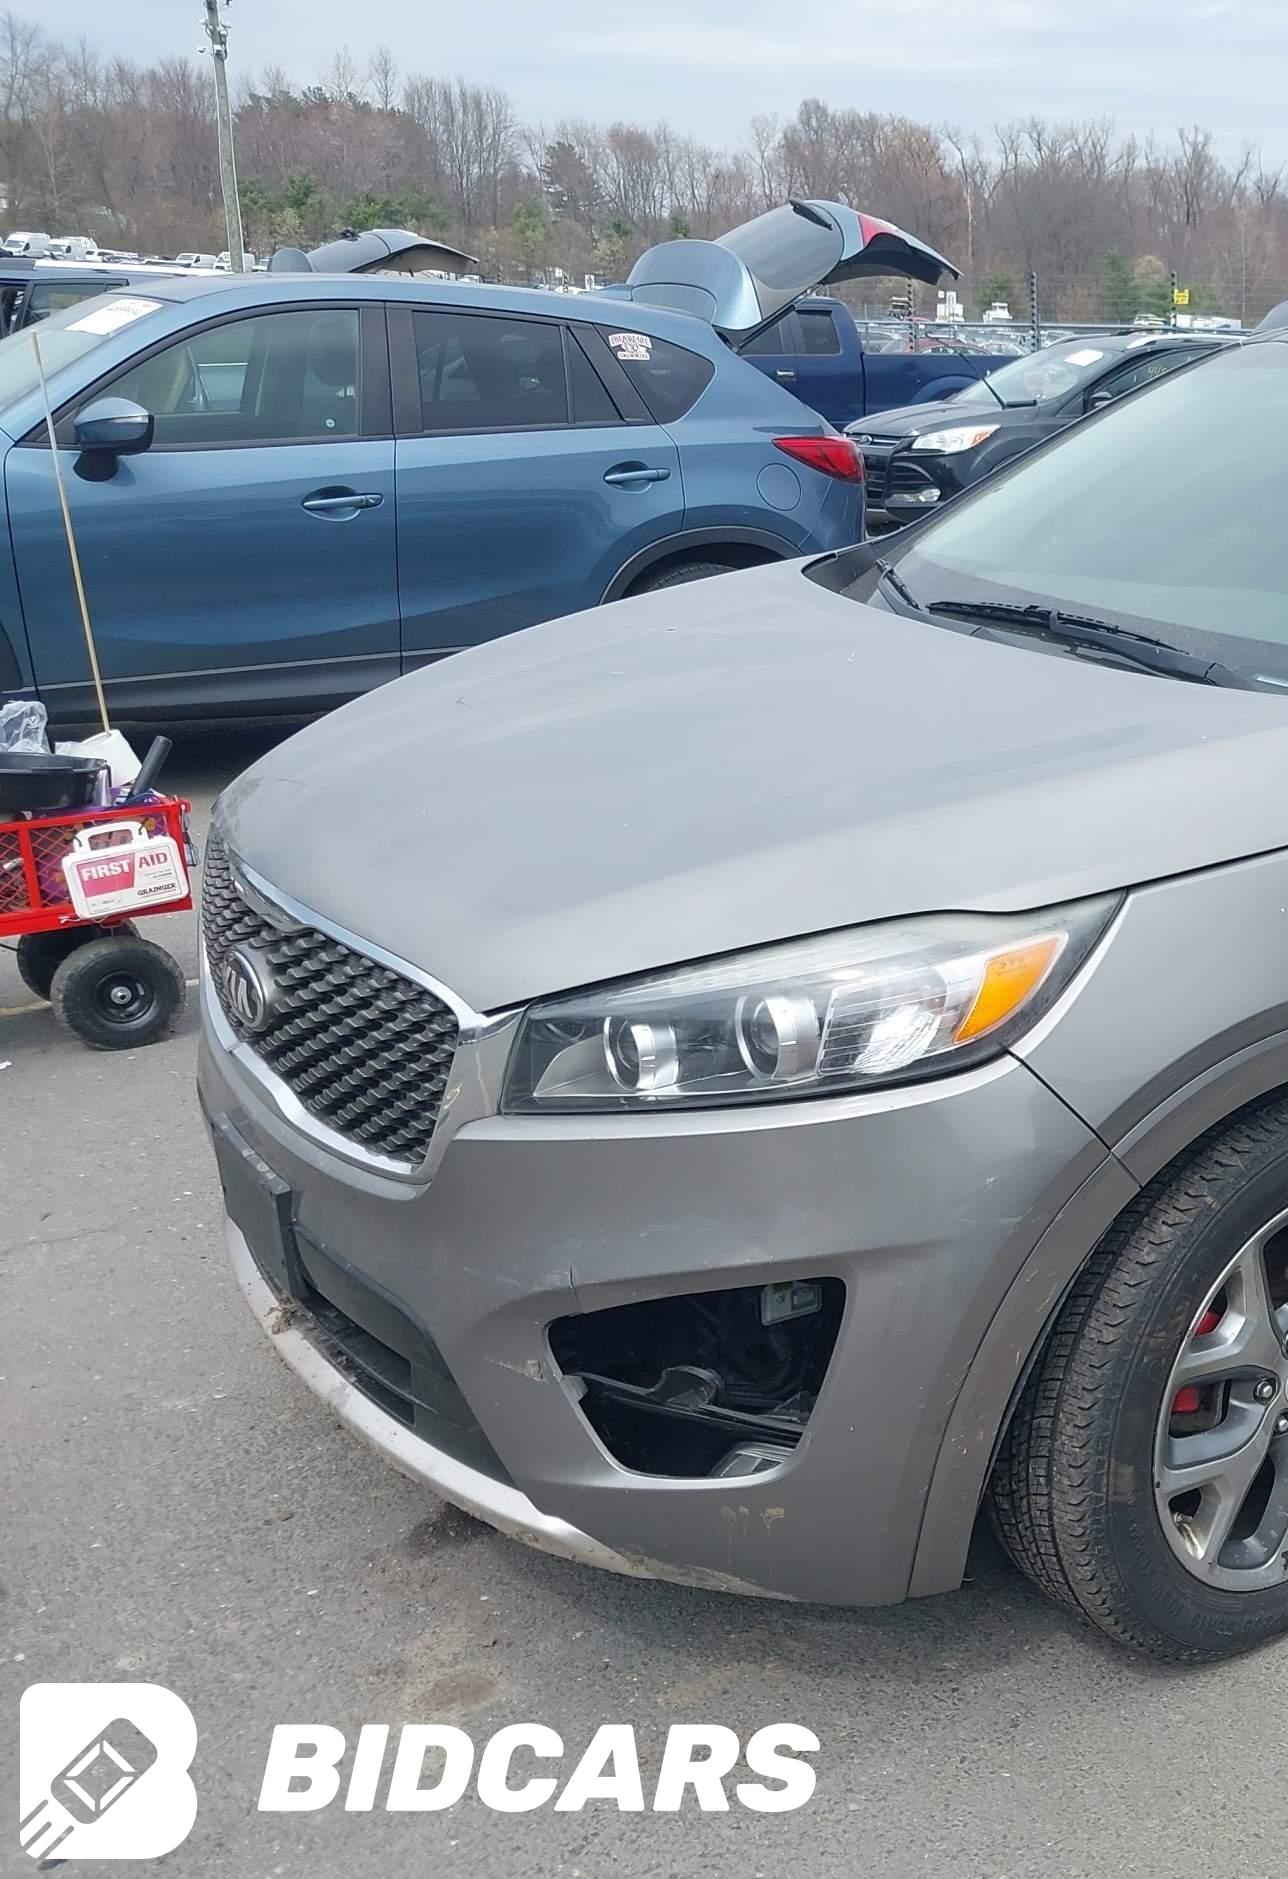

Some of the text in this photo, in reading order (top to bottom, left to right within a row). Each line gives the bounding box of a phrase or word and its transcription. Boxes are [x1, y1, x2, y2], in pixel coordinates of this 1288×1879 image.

[81, 860, 130, 881] FIRST
[139, 852, 168, 869] AID
[137, 882, 177, 896] GRAINGER
